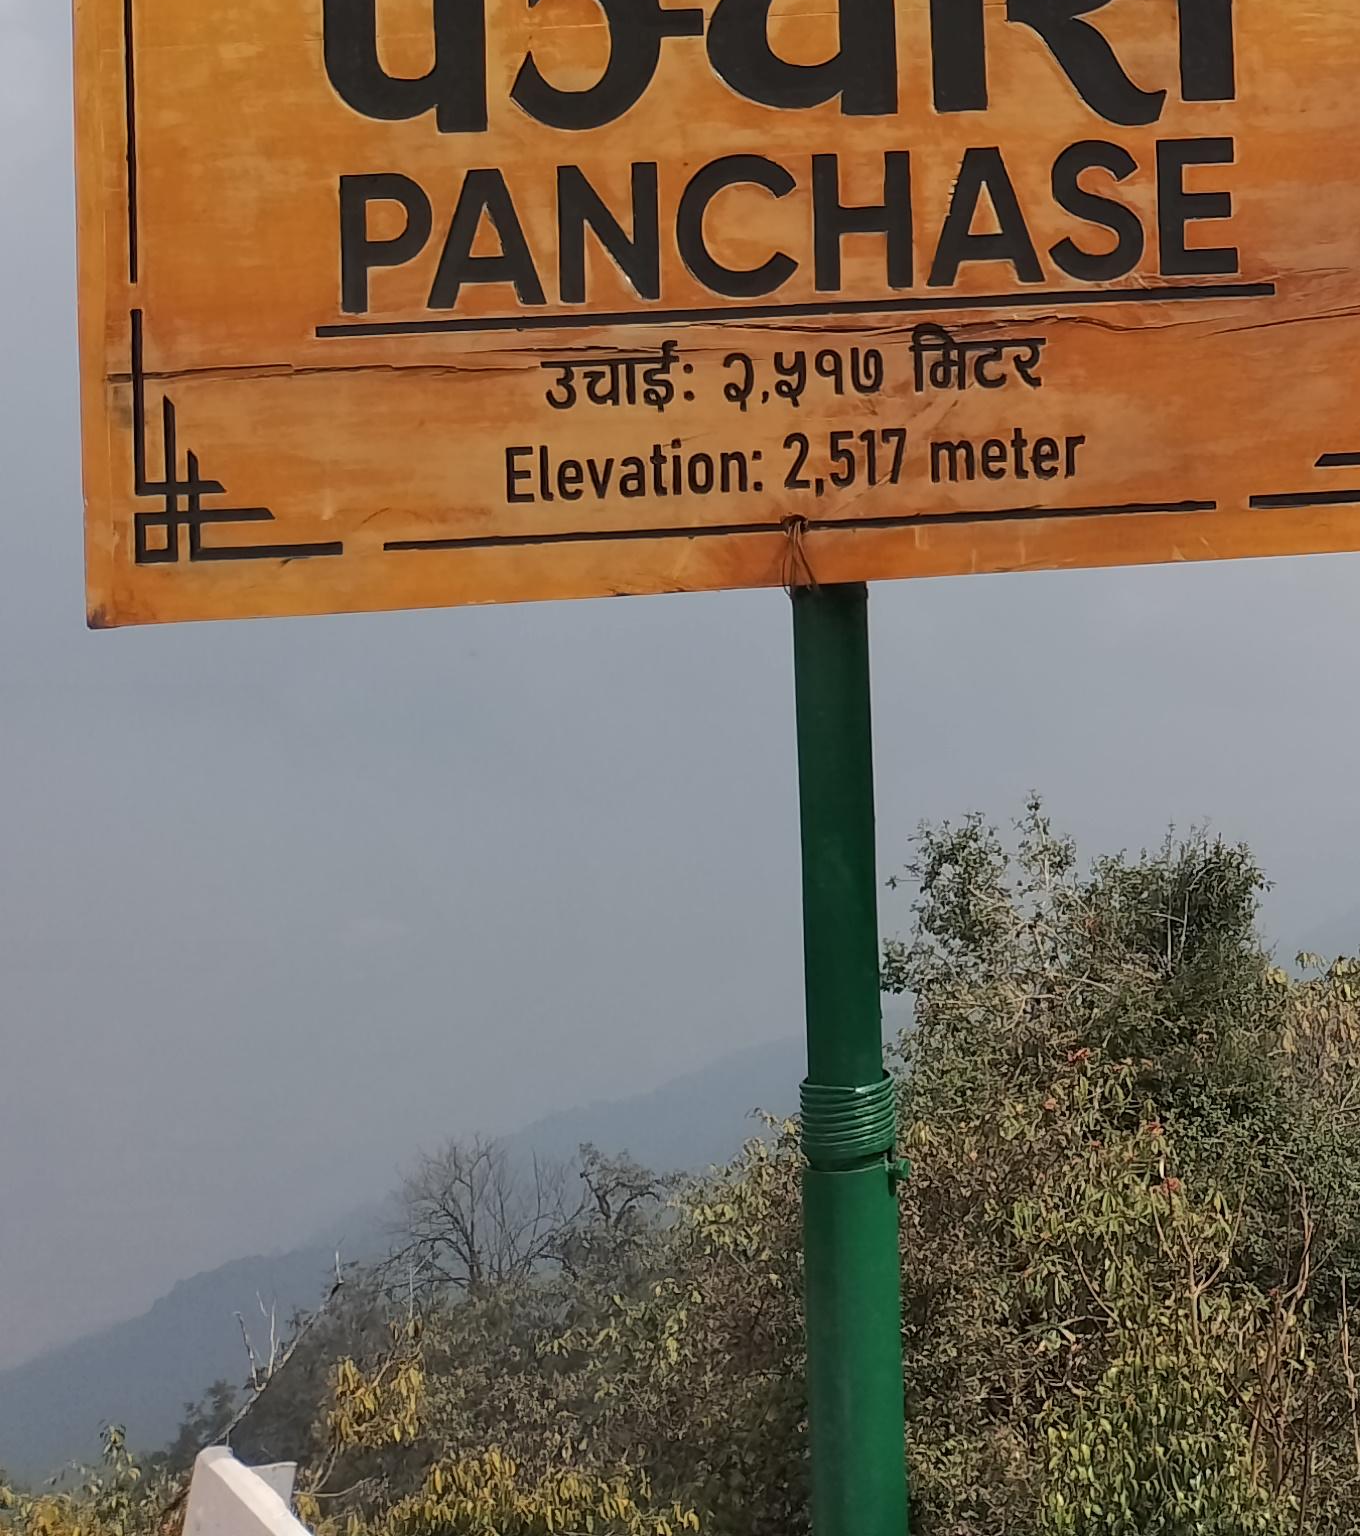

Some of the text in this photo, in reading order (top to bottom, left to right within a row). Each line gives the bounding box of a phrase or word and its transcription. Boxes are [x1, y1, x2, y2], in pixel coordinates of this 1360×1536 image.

[339, 136, 1240, 313] PANCHASE
[540, 322, 1047, 413] उचाई: २,५१७ मिटर
[504, 427, 1086, 505] Elevation: 2,517 meter
